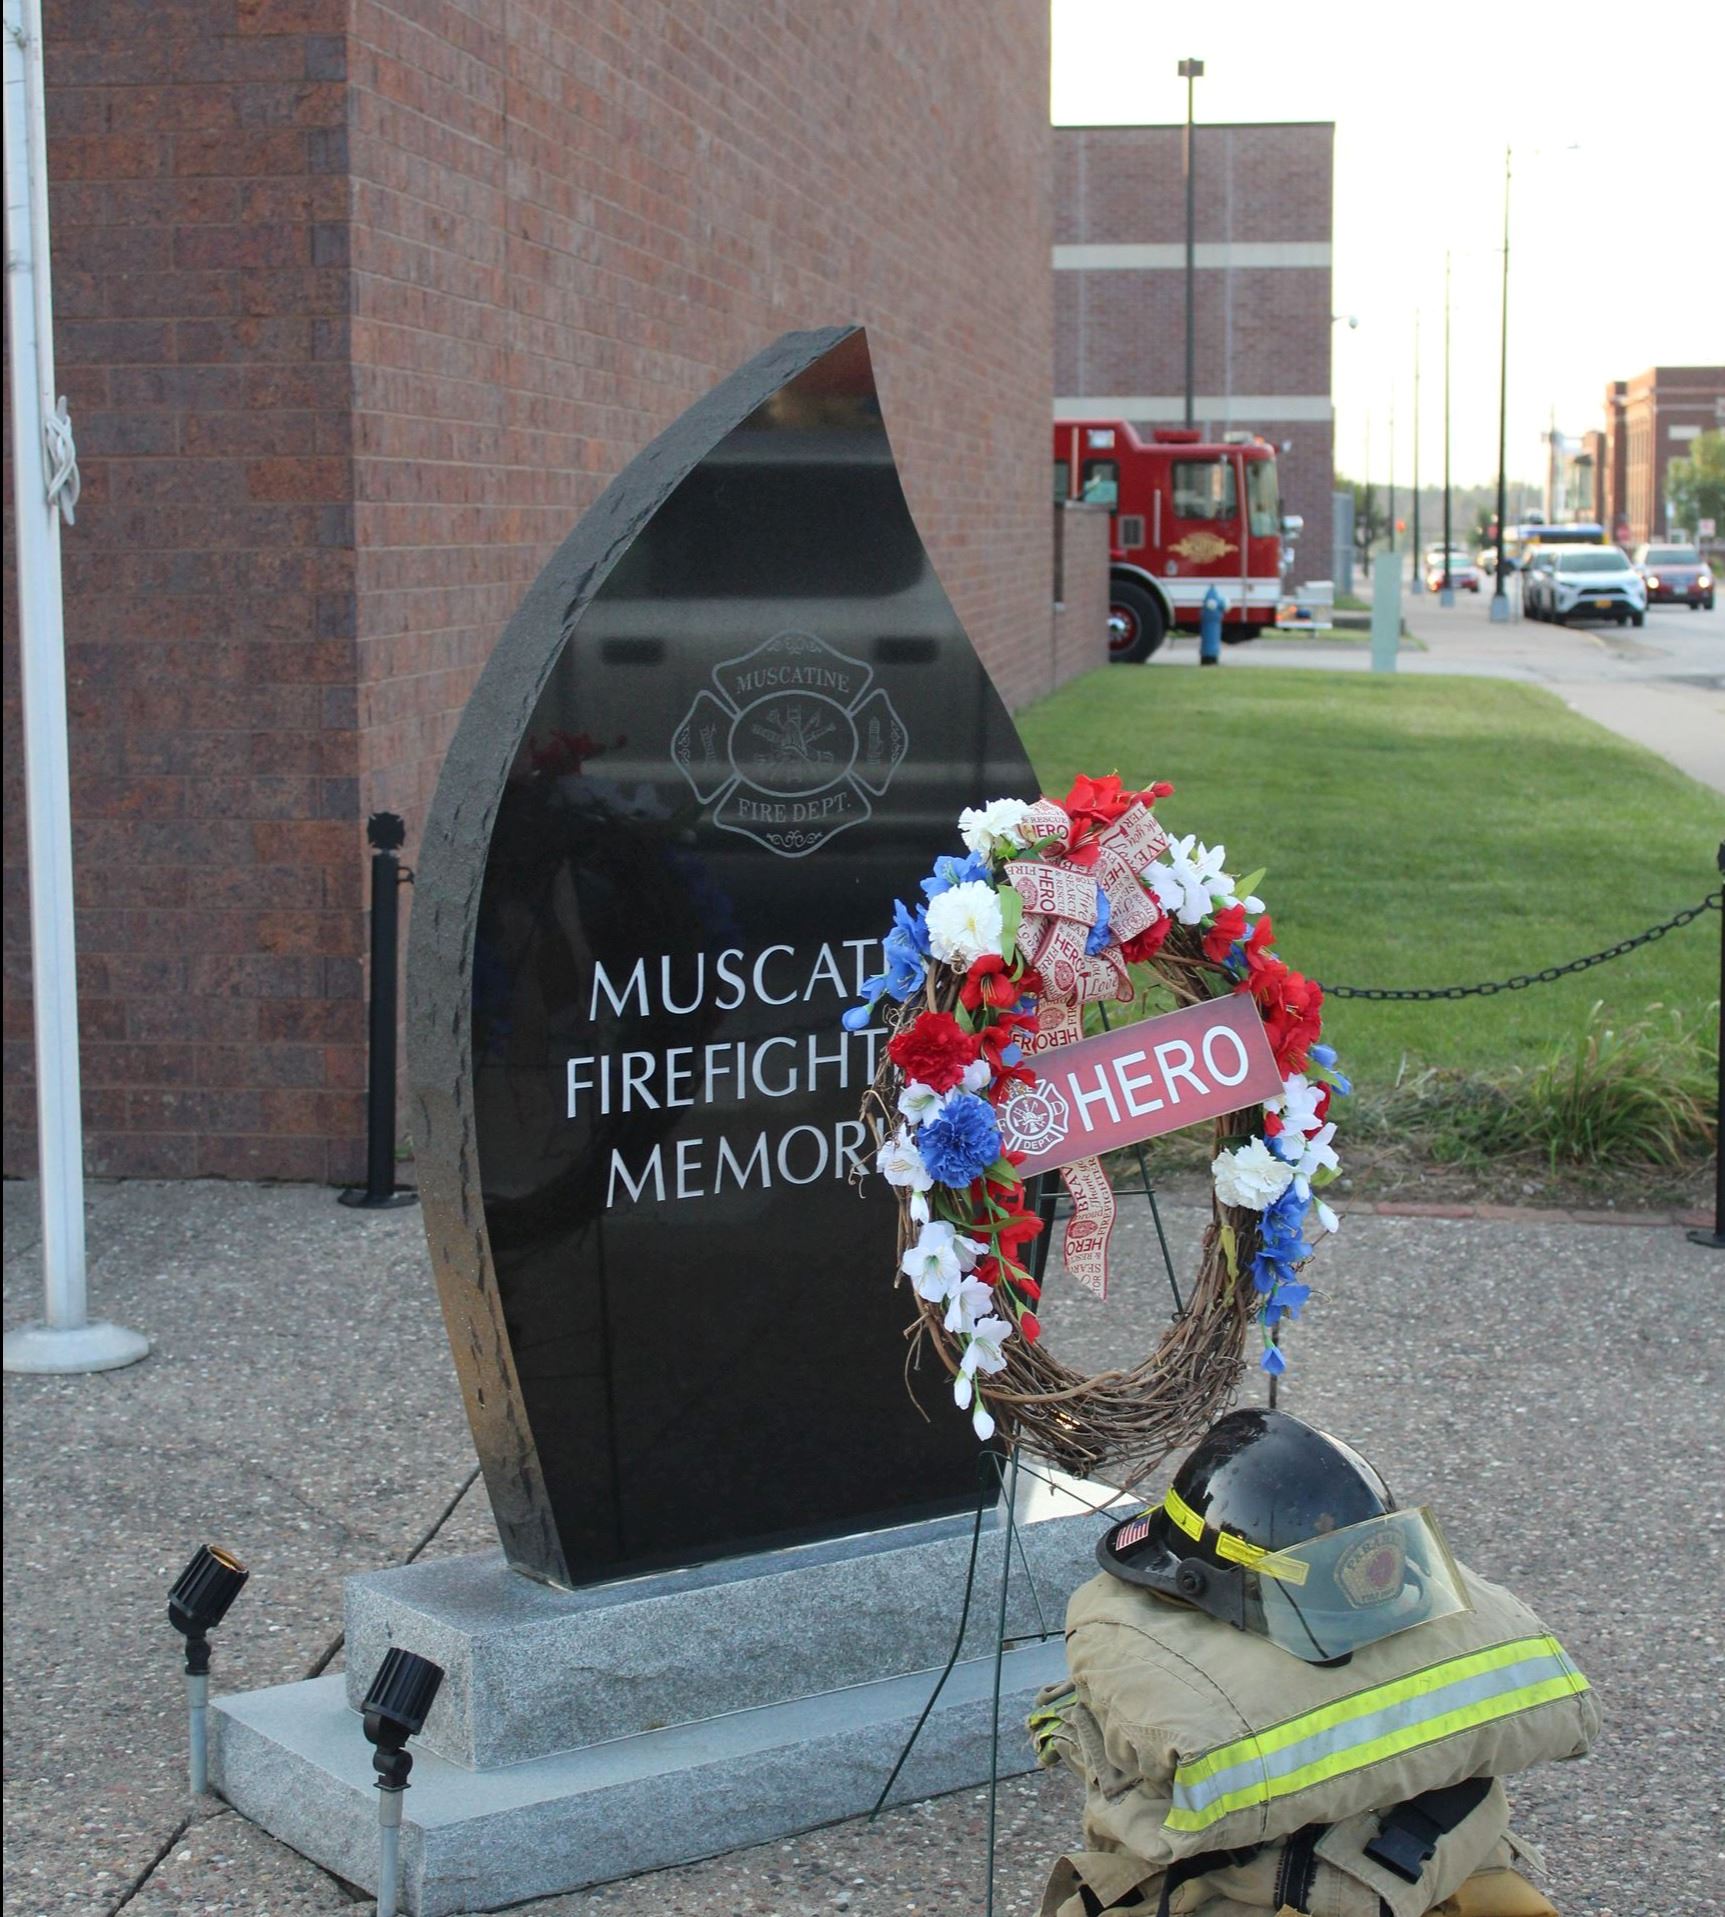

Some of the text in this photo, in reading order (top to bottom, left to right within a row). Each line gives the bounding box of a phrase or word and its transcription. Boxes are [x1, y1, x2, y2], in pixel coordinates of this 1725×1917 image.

[736, 666, 850, 694] MUSCATINE
[738, 791, 851, 823] FIRE DEPT.
[1038, 868, 1056, 912] HERO
[1103, 862, 1126, 892] HER
[1064, 872, 1077, 917] SEARCH
[1038, 946, 1059, 972] FIRE
[589, 938, 890, 1021] MUSCAT
[1037, 1028, 1079, 1050] HERO
[566, 1027, 889, 1118] FIREFIGHT
[1067, 1025, 1250, 1132] HERO
[1050, 1100, 1065, 1116] D
[1023, 1134, 1054, 1150] DEPT.
[1060, 1166, 1088, 1212] BRAV
[1067, 1237, 1103, 1256] HERO
[1071, 1263, 1101, 1274] SEAR
